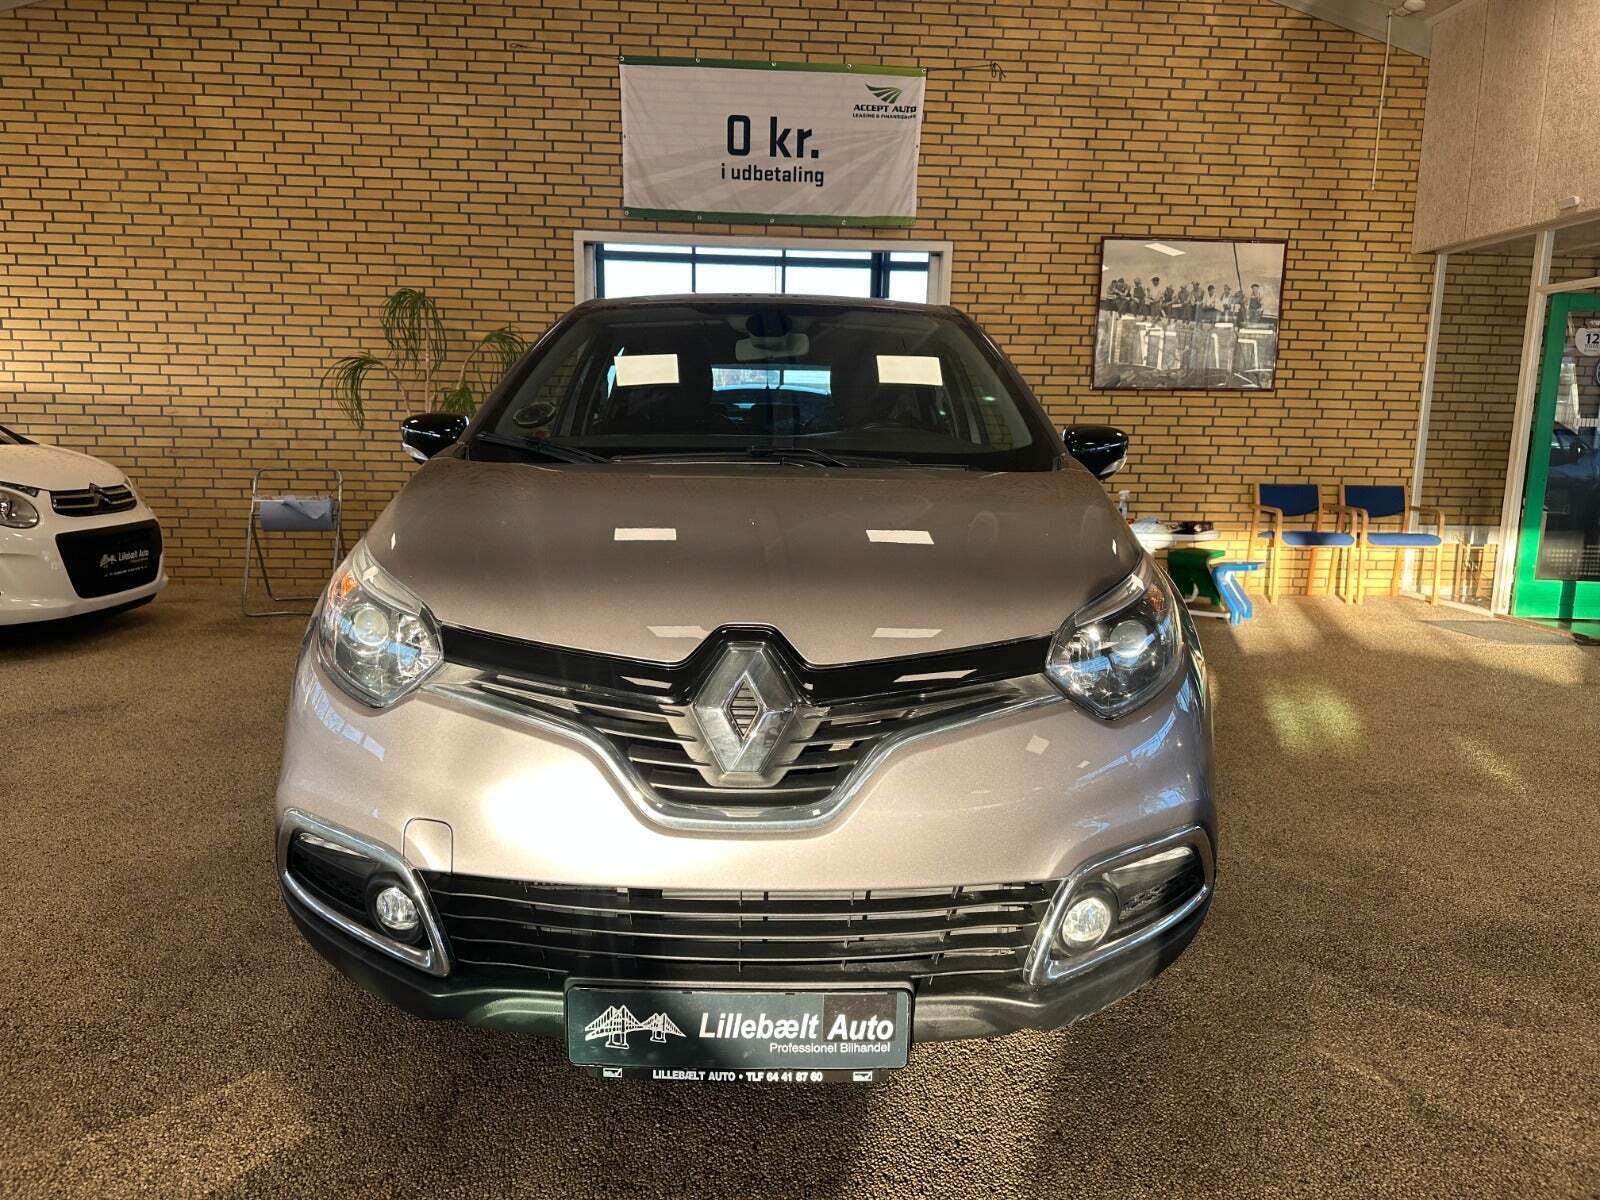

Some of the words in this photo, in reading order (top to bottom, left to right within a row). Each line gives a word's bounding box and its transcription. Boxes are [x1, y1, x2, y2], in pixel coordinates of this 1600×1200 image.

[853, 104, 889, 112] ACCEPT
[892, 105, 917, 113] AUTO
[727, 114, 751, 156] 0
[769, 116, 819, 159] kr.
[721, 162, 726, 180] i
[731, 164, 824, 188] udbetaling
[699, 1012, 819, 1040] Lillebælt
[827, 1013, 895, 1041] Auto
[769, 1042, 837, 1054] Professionel
[839, 1042, 891, 1053] Bilhandel
[652, 1069, 706, 1081] LILLEBÆLT
[708, 1071, 736, 1081] AUTO
[746, 1071, 765, 1082] TLF
[780, 1071, 793, 1082] 41
